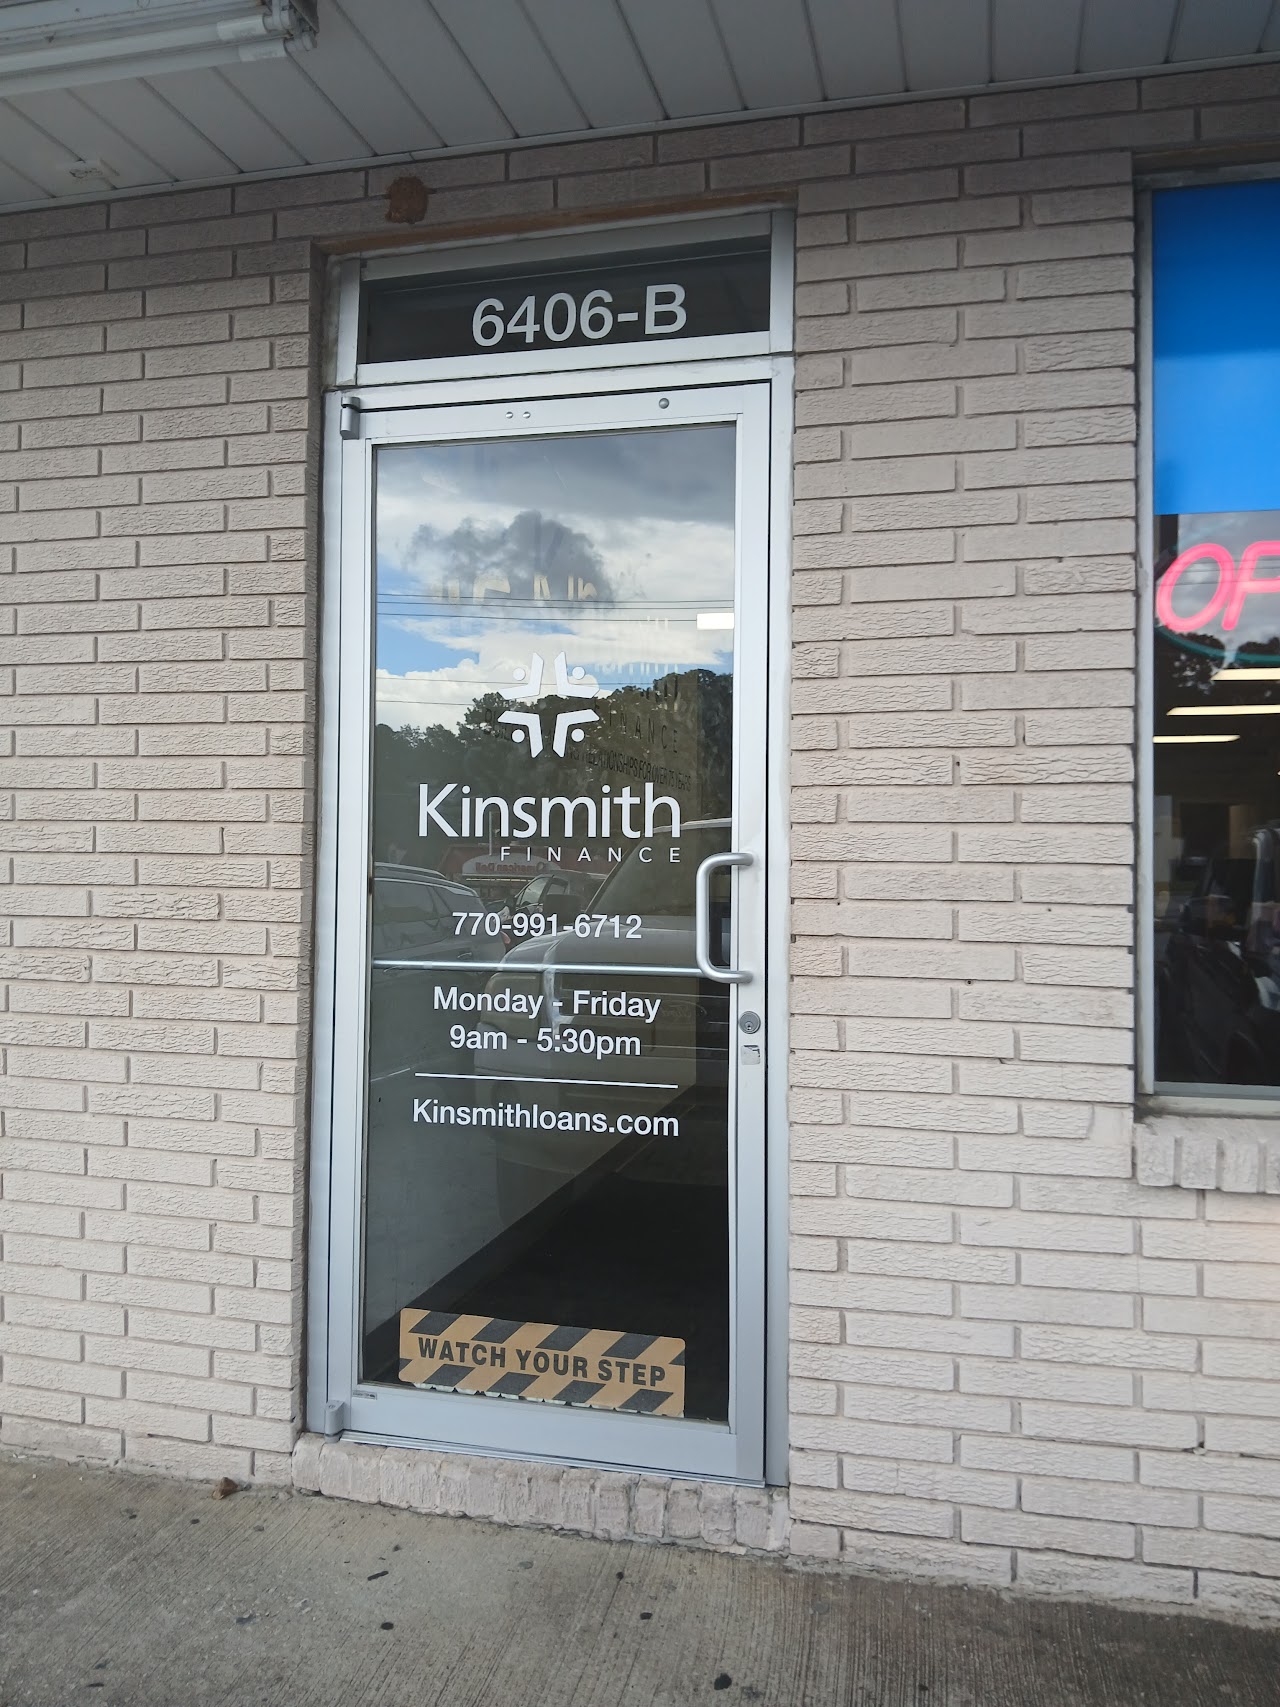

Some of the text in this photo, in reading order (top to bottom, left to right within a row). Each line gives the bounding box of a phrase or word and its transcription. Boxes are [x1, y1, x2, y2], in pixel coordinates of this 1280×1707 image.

[472, 283, 687, 347] 6406-B
[418, 782, 682, 839] Kinsmith
[500, 846, 681, 863] FINANCE
[452, 911, 642, 939] 770-991-6712
[433, 986, 543, 1019] Monday
[573, 990, 661, 1023] Friday
[450, 1025, 507, 1050] 9am
[536, 1027, 641, 1060] 5:30pm
[413, 1098, 679, 1137] Kinsmithloans.com
[418, 1336, 666, 1387] WATCH YOUR STEP
